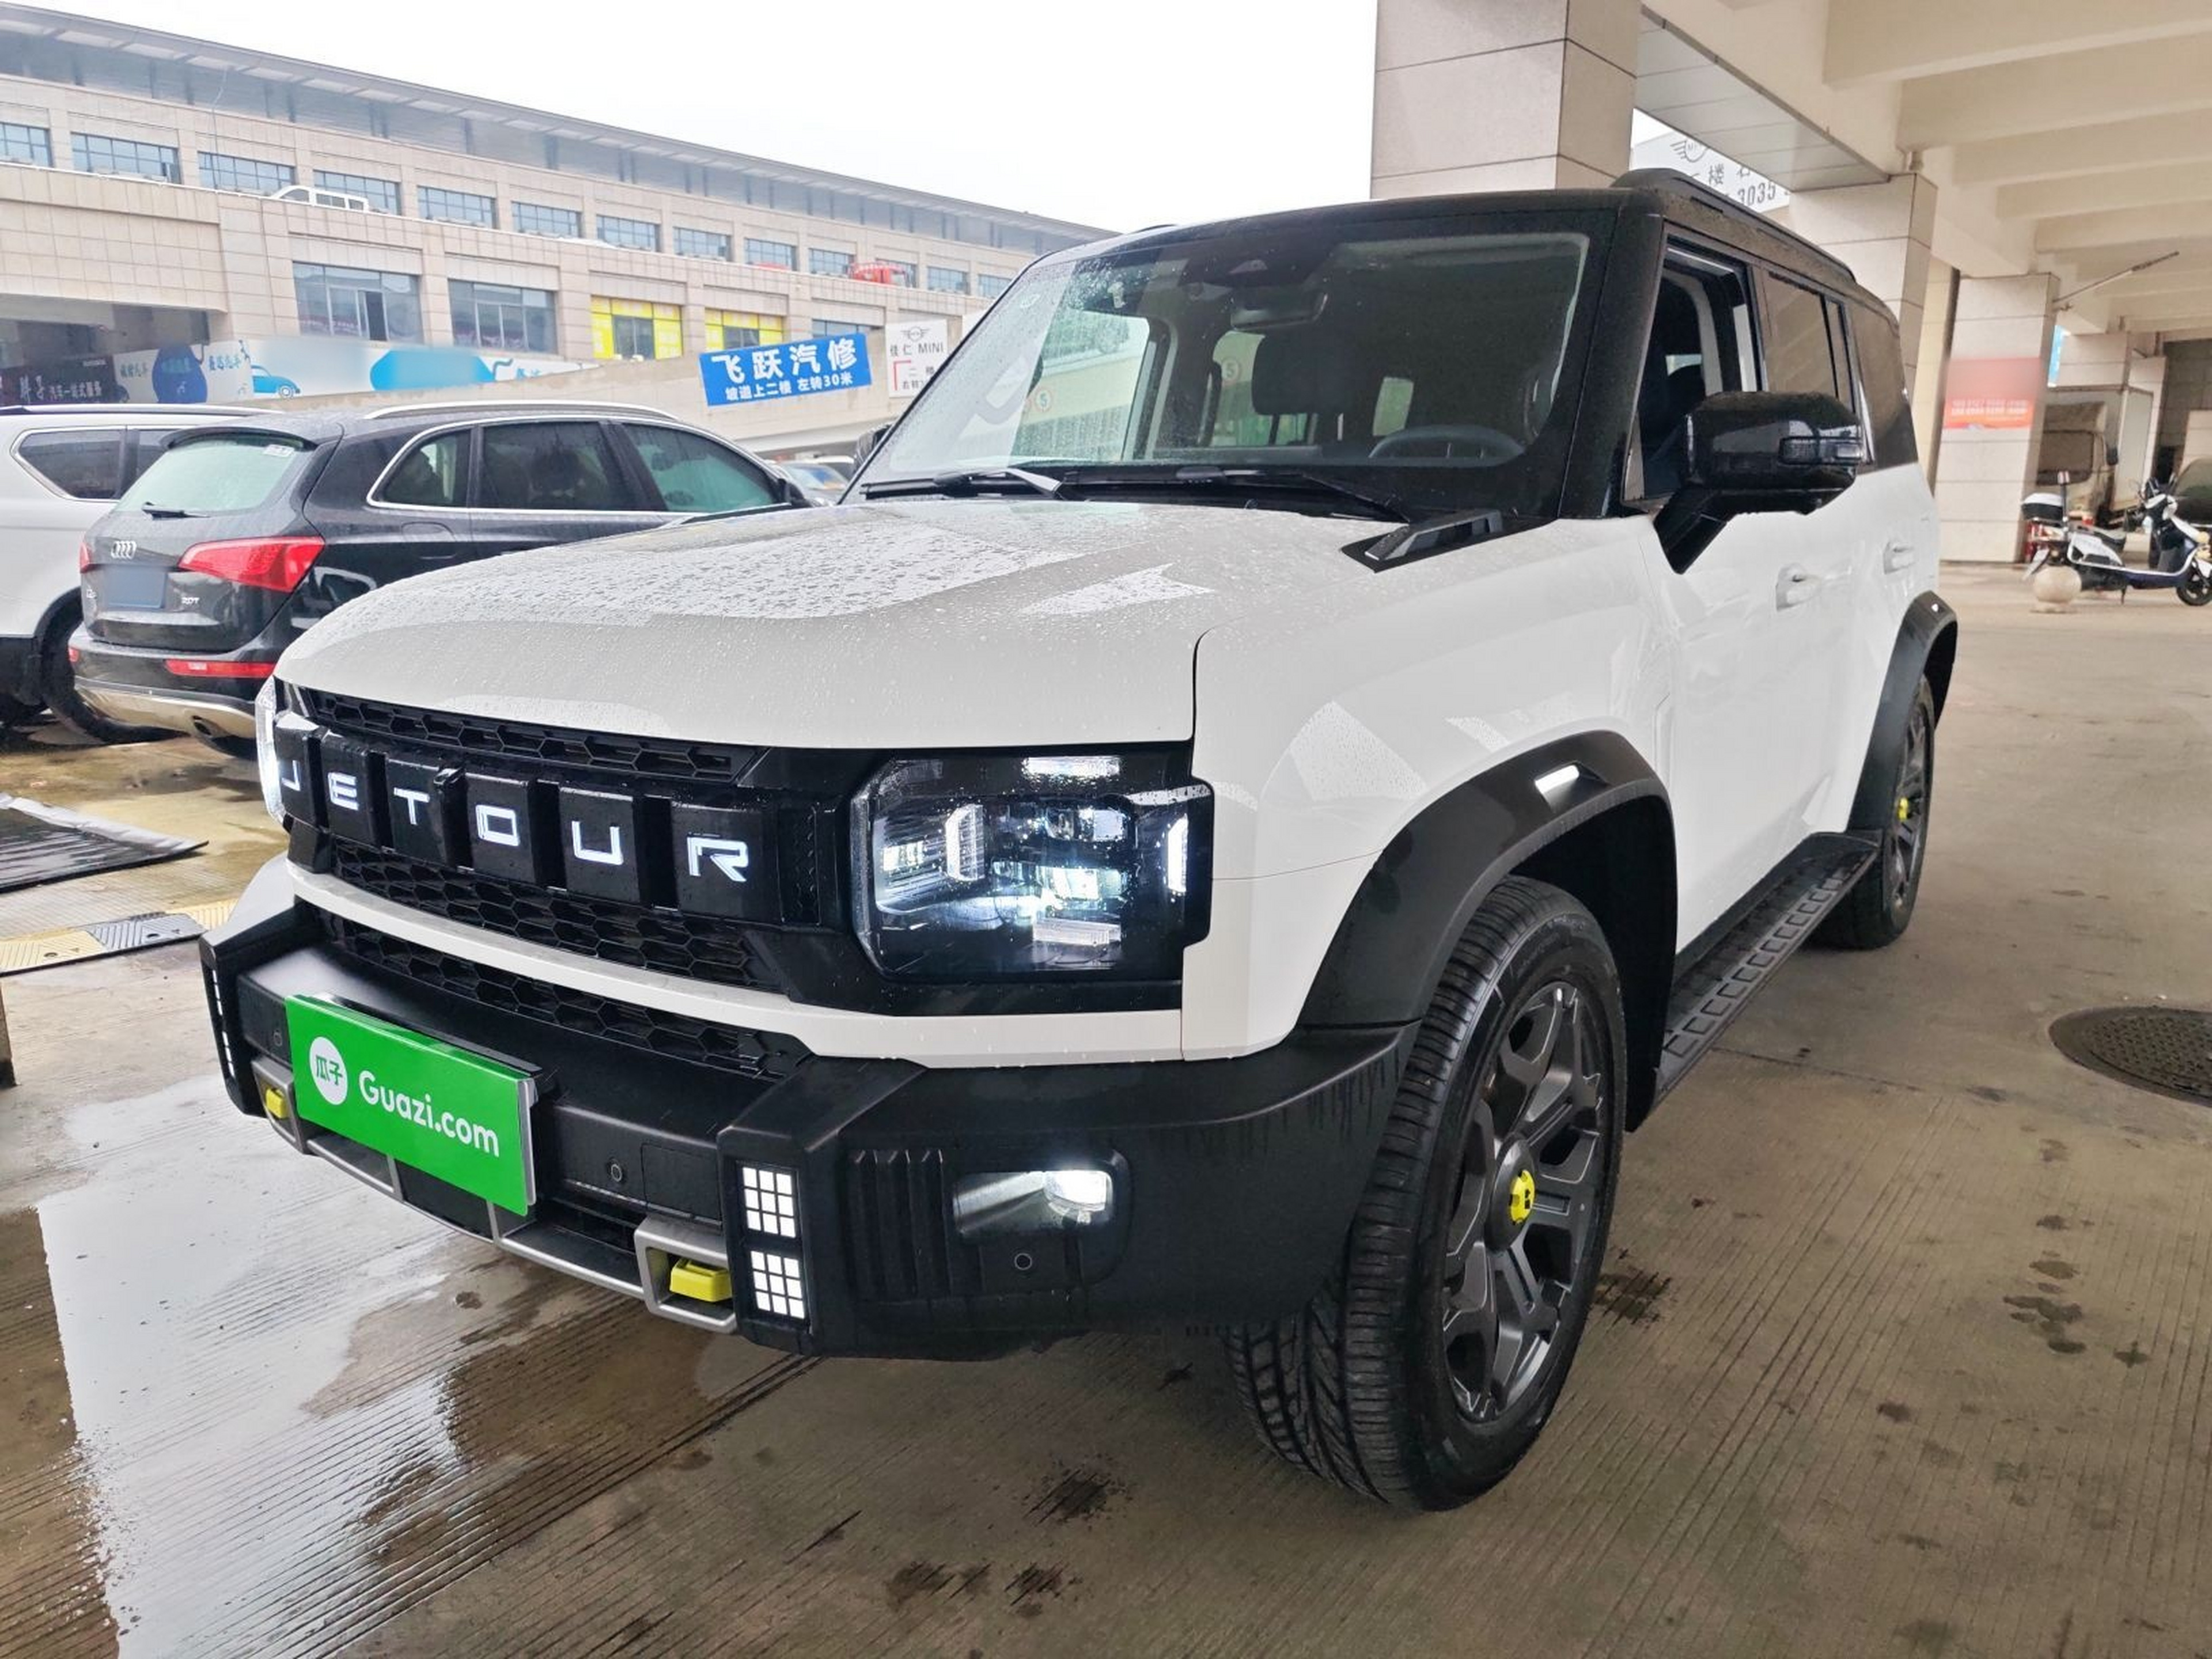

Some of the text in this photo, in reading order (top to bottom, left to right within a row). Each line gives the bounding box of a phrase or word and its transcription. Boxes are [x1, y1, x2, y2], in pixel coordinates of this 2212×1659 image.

[711, 338, 857, 384] 飞跃汽修
[918, 342, 944, 354] MINI
[725, 371, 853, 402] 坡道上二楼 左转30米
[279, 759, 749, 882] JETOUR
[316, 1054, 343, 1086] 瓜子
[358, 1070, 499, 1157] Guazi.com
